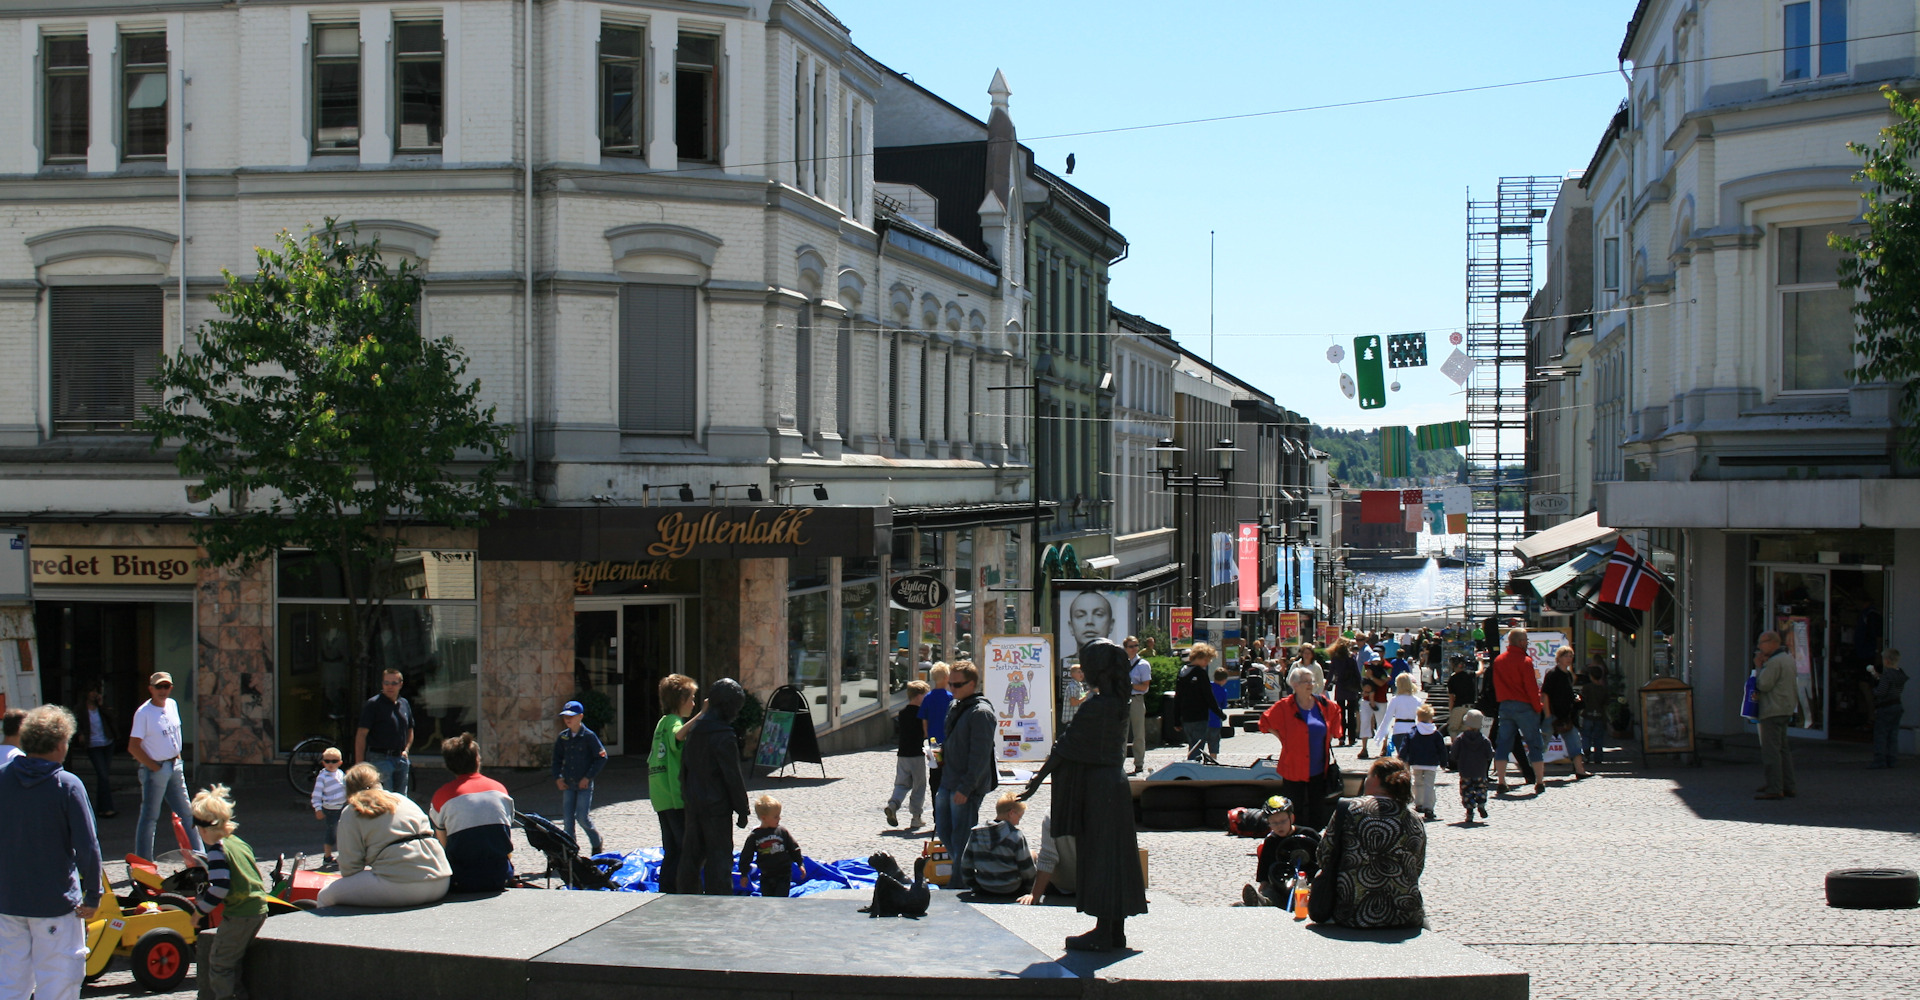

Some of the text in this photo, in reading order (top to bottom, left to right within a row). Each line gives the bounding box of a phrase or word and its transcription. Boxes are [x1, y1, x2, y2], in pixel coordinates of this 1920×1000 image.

[1534, 498, 1563, 508] AKTIV
[647, 507, 815, 559] Gyllenlakk
[112, 555, 190, 581] Bingo
[897, 580, 928, 595] Gyllen
[992, 643, 1042, 664] BARNE
[1527, 640, 1560, 660] RNE
[995, 662, 1021, 671] festival
